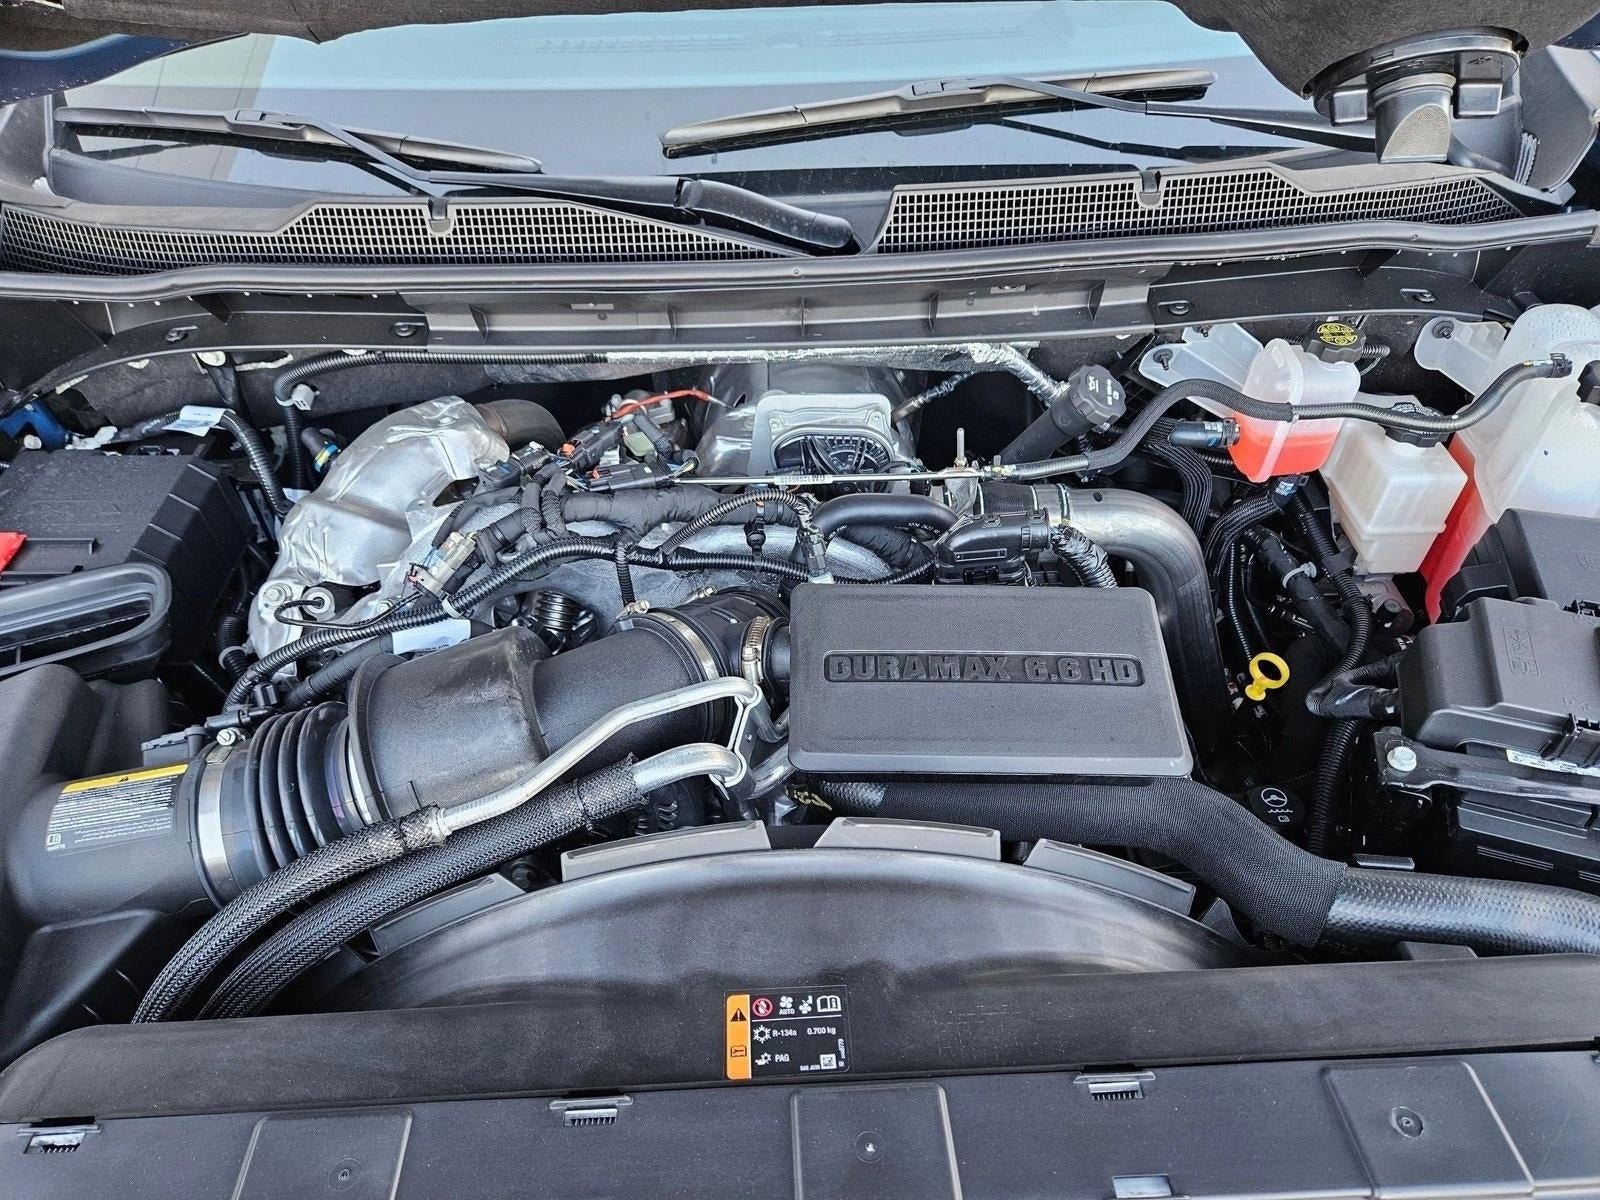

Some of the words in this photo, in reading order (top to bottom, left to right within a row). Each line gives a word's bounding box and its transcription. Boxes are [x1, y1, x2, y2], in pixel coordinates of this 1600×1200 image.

[828, 654, 1011, 681] DURAMAX
[1024, 656, 1082, 683] 6.6
[1089, 658, 1140, 684] HD
[772, 1029, 797, 1037] R-134a
[807, 1027, 826, 1035] 0.700
[827, 1026, 836, 1035] kg
[775, 1053, 790, 1062] PAG
